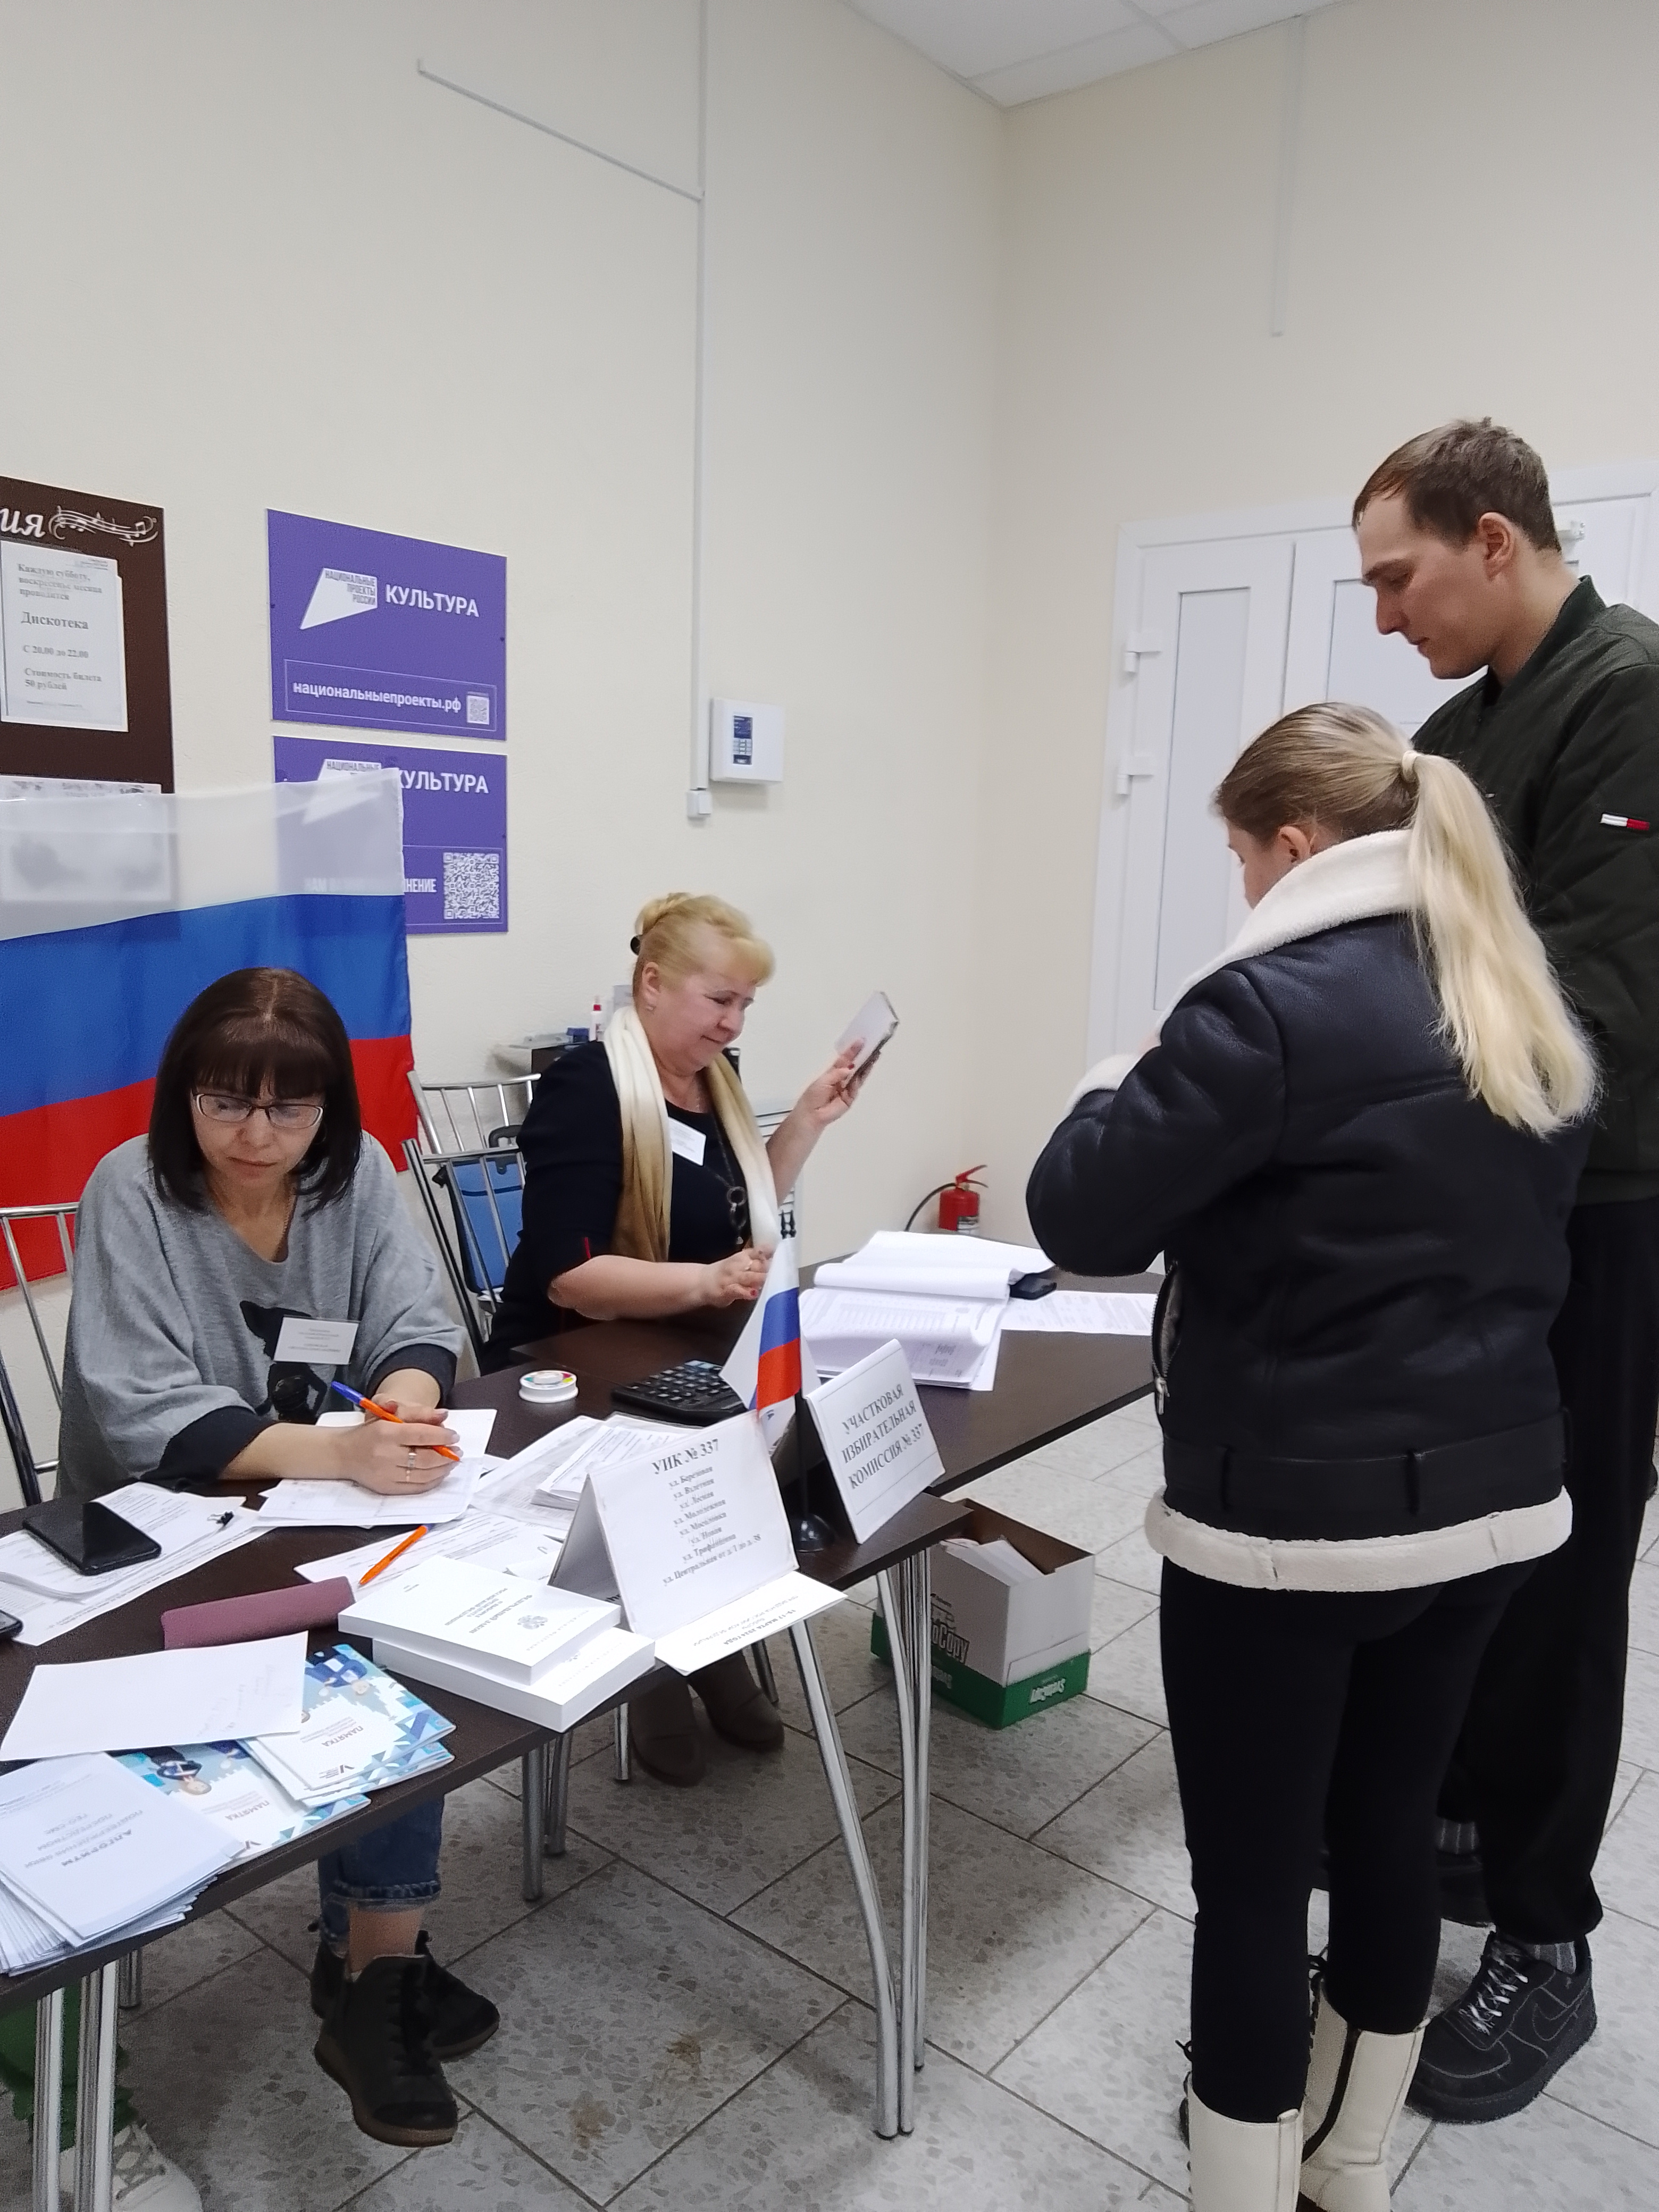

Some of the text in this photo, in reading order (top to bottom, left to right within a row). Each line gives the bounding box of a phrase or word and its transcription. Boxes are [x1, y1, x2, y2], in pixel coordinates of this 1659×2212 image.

[385, 584, 479, 617] КУЛЬТУРА
[21, 611, 88, 629] Дискотека
[37, 681, 67, 691] рублей
[293, 682, 462, 714] национальныепроекты.рф
[404, 878, 437, 893] НЕНИЕ
[842, 1384, 903, 1435] УЧАСТКОВАЯ
[841, 1400, 917, 1463] ИЗБИРАТЕЛЬНАЯ
[651, 1438, 718, 1474] УИК № 337
[848, 1441, 903, 1489] КОМИССИЯ
[756, 1618, 778, 1629] МАРТА
[321, 1725, 363, 1746] ПАМЯТКА
[225, 1799, 270, 1821] ПАМЯТКА
[61, 1829, 131, 1866] АЛГОРИТМ
